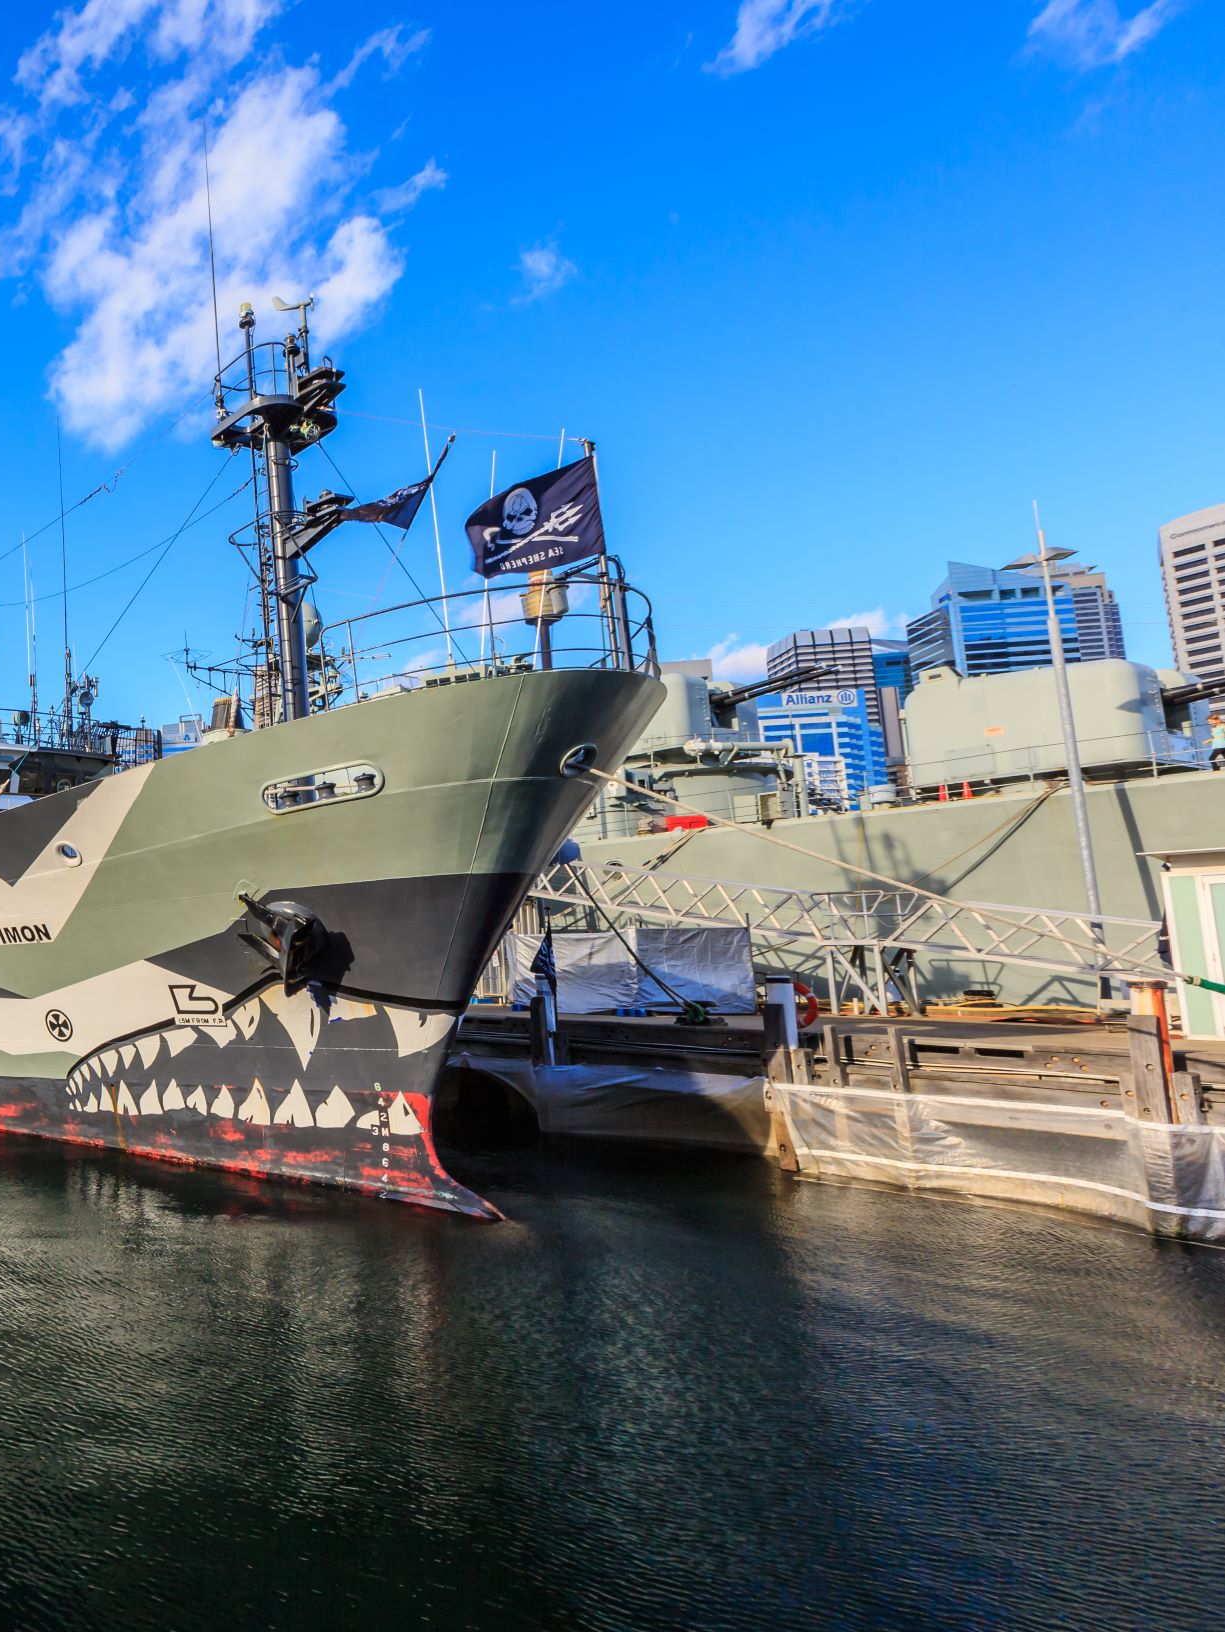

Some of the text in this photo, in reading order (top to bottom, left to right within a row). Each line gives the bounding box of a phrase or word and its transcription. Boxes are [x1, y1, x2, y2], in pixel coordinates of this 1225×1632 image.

[786, 694, 832, 705] Allianz
[379, 1112, 388, 1122] 2
[382, 1142, 390, 1152] 8
[381, 1157, 389, 1168] 6
